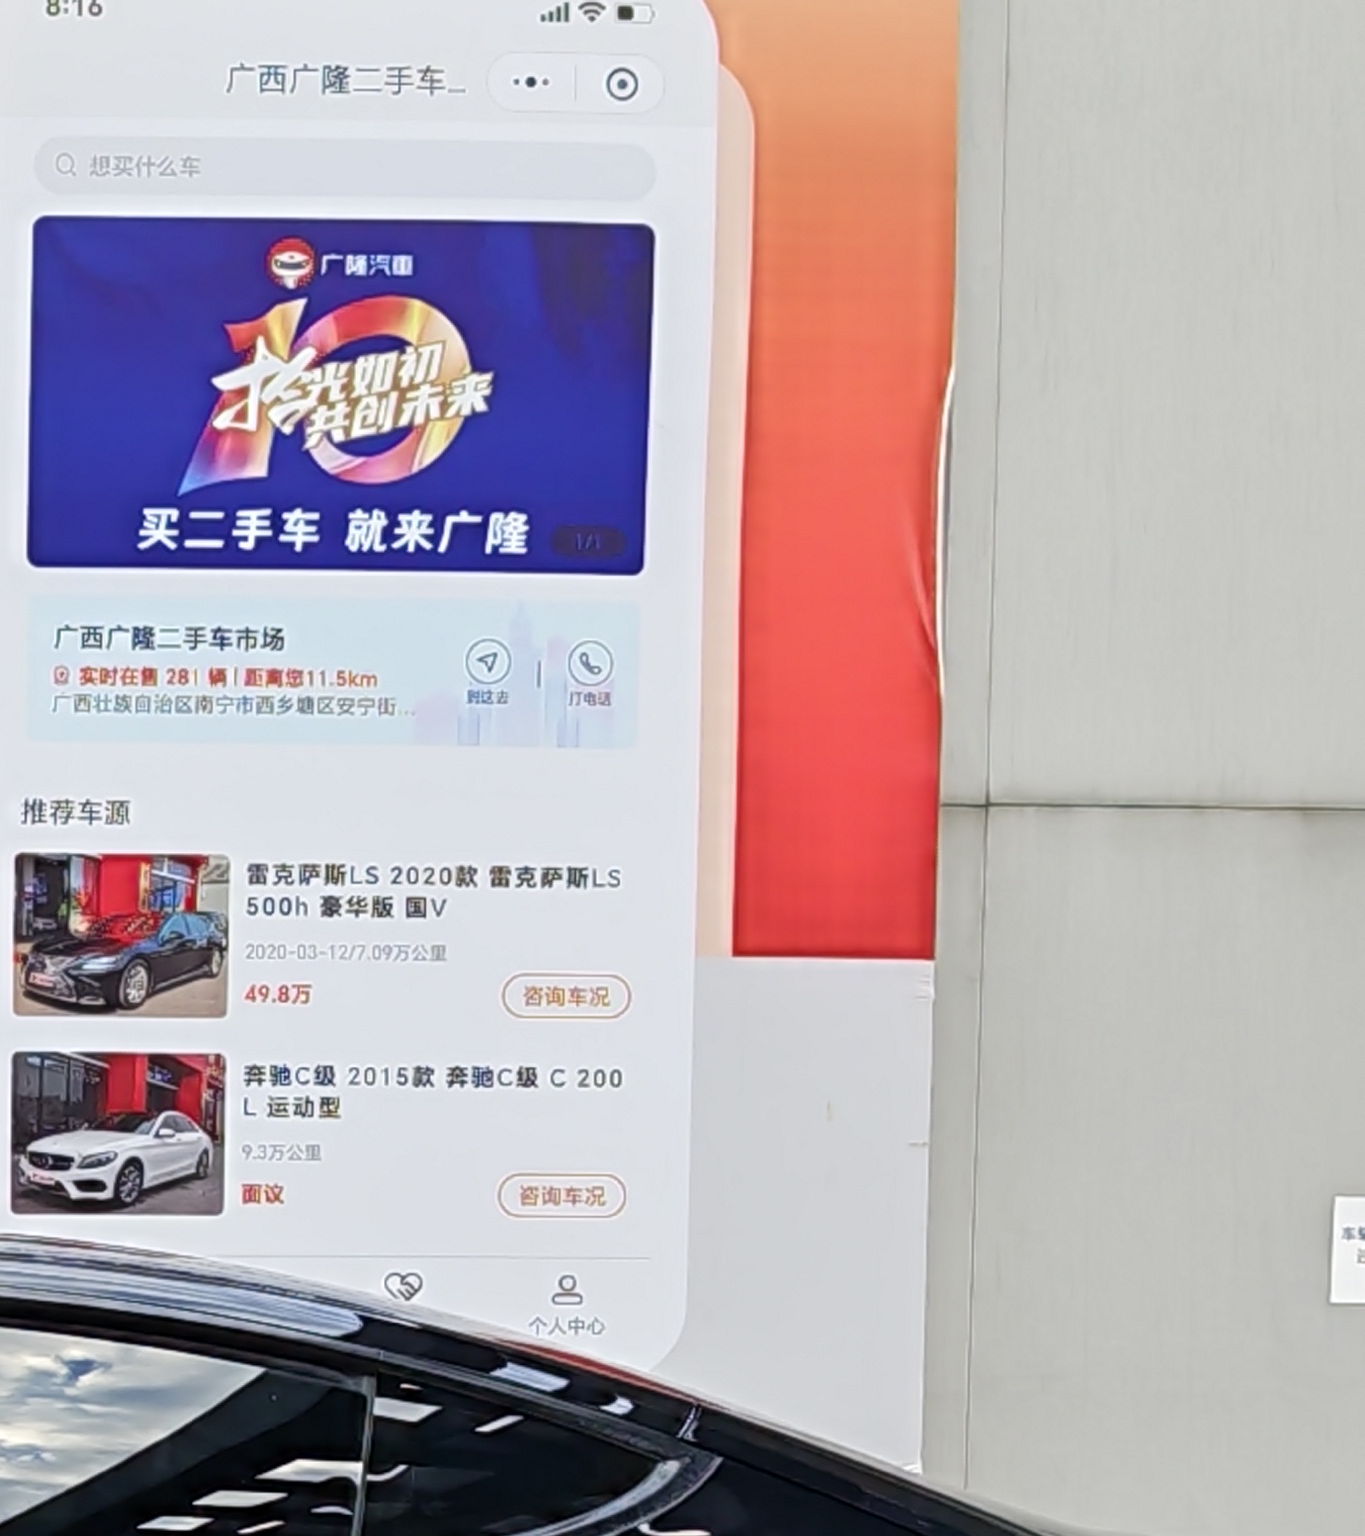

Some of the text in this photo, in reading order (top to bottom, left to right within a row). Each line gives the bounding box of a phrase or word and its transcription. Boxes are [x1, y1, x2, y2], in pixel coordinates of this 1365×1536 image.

[89, 155, 202, 178] 想买什么车
[138, 507, 530, 555] 买二手车 就来广隆
[54, 625, 285, 651] 广西广隆二手车市场
[79, 666, 158, 688] 实时在售
[20, 798, 131, 827] 推荐车源
[247, 863, 621, 889] 雷克萨斯LS 2020款 雷克萨斯LS
[246, 896, 447, 918] 500h 豪华版 国V
[245, 985, 312, 1004] 49.8万
[523, 986, 610, 1007] 咨询车况
[244, 1064, 623, 1088] 奔驰C级 2015款 奔驰C级 C 200
[243, 1096, 341, 1119] L 运动型
[242, 1144, 321, 1162] 9.3万公里
[241, 1184, 284, 1204] 面议
[519, 1186, 606, 1207] 咨询车况
[528, 1315, 605, 1337] 个人中心
